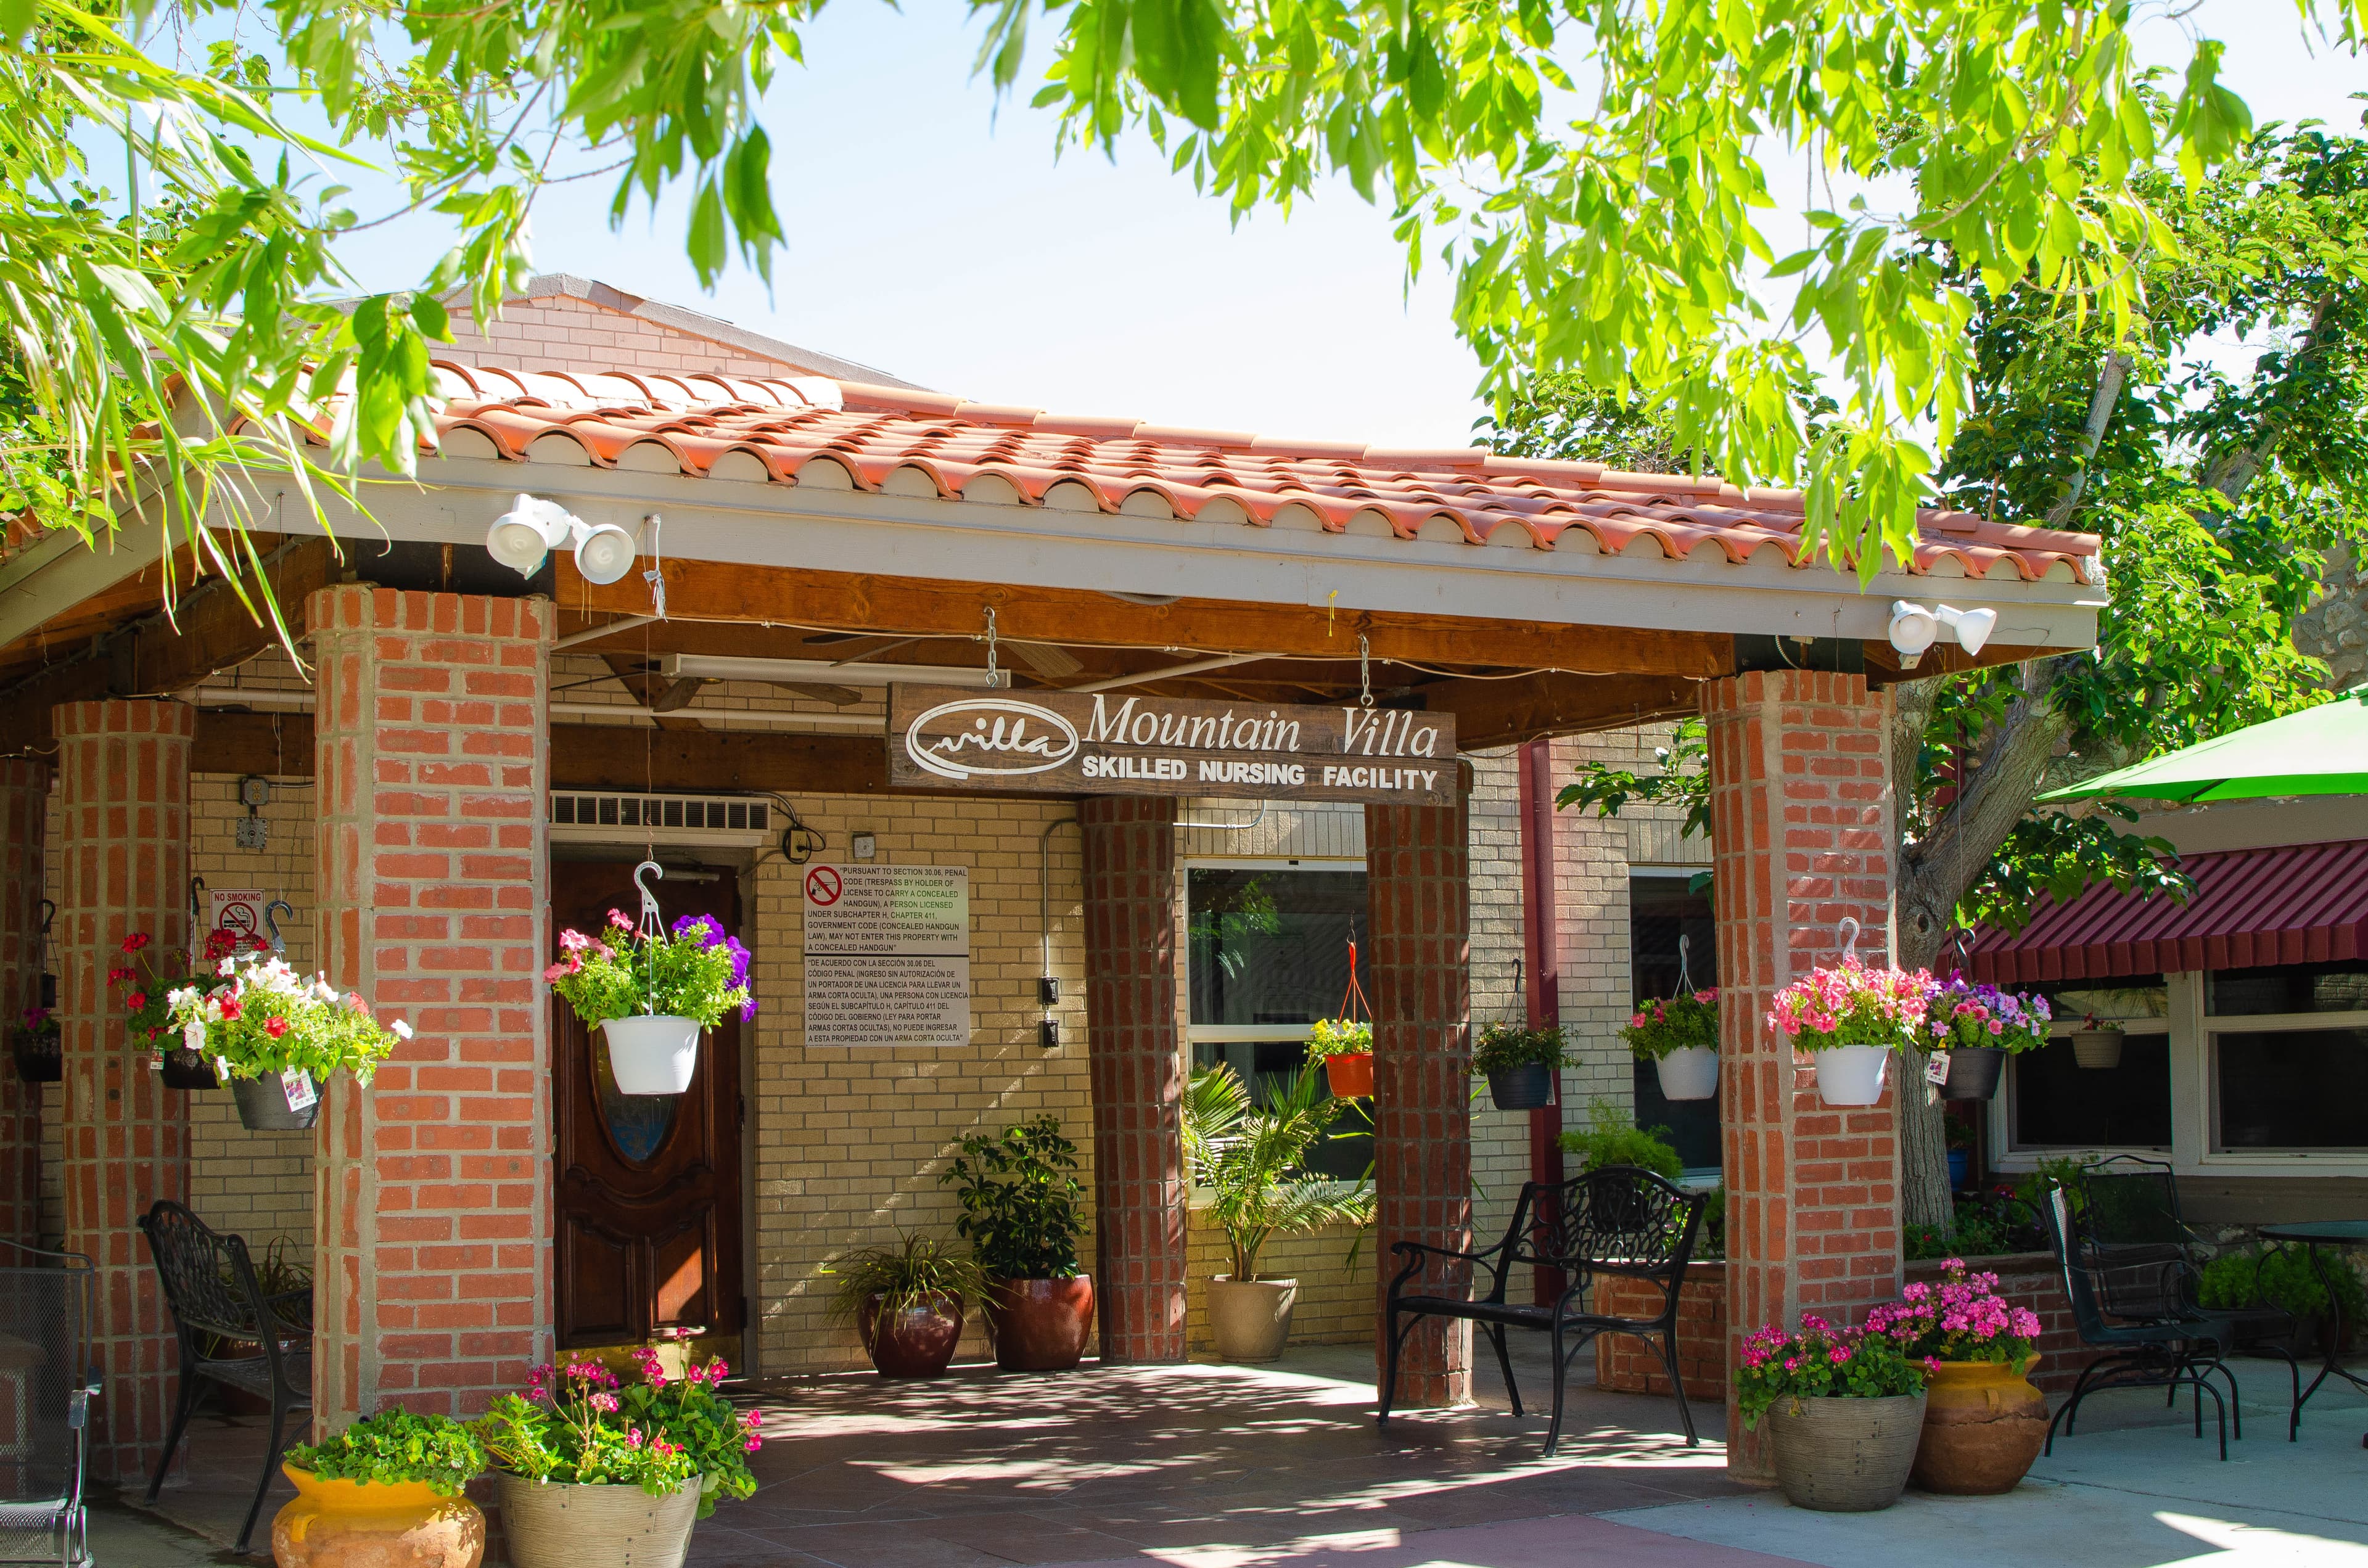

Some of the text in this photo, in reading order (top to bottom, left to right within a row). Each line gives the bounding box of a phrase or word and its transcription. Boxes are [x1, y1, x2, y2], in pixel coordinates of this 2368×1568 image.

[1081, 693, 1439, 758] Mountain Villa
[1082, 755, 1438, 791] SKILLED NURSING FACILITY
[893, 868, 923, 876] SECTION
[924, 868, 943, 876] 30.06,
[944, 868, 967, 876] PENAL
[842, 877, 863, 886] CODE
[864, 878, 902, 887] (TRESPASS
[915, 879, 943, 887] HOLDER
[944, 879, 954, 887] OF
[215, 893, 261, 901] NO SMOKING
[843, 889, 873, 897] LICENSE
[873, 889, 884, 897] TO
[885, 889, 908, 897] CARRY
[916, 890, 958, 898] CONCEALED
[843, 900, 953, 908] HANDGUN), A PERSON LICENSED
[807, 910, 937, 920] UNDER SUBCHAPTER H, CHAPTER 411,
[807, 921, 959, 930] GOVERNMENT CODE (CONCEALED HANDGUN
[807, 932, 958, 942] LAW), MAY NOT ENTER THIS PROPERTY WITH
[808, 943, 813, 951] A
[814, 943, 857, 951] CONCEALED
[820, 959, 852, 967] ACUERDO
[852, 959, 867, 967] CON
[868, 959, 877, 967] LA
[877, 959, 905, 967] SECCIÓN
[906, 959, 922, 967] 30.06
[923, 959, 935, 967] DEL
[807, 969, 955, 978] CÓDIGO PENAL (INGRESO SIN AUTORIZACIÓN DE
[808, 980, 817, 988] UN
[818, 980, 853, 988] PORTADOR
[854, 980, 863, 988] DE
[864, 980, 878, 988] UNA
[879, 980, 908, 988] LICENCIA
[908, 980, 926, 988] PARA
[926, 980, 950, 988] LLEVAR
[808, 991, 968, 999] ARMA CORTA OCULTA), UNA PERSONA CON LICENCIA
[808, 1001, 949, 1011] SEGÚN EL SUBCAPÍTULO H, CAPÍTULO 411 DEL
[808, 1012, 941, 1021] CÓDIGO DEL GOBIERNO (LEY PARA PORTAR
[808, 1023, 957, 1032] ARMAS CORTAS OCULTAS), NO PUEDE INGRESAR
[808, 1034, 813, 1043] A
[814, 1034, 830, 1042] ESTA
[831, 1034, 868, 1043] PROPIEDAD
[869, 1034, 882, 1042] CON
[884, 1034, 893, 1042] UN
[894, 1034, 913, 1042] ARMA
